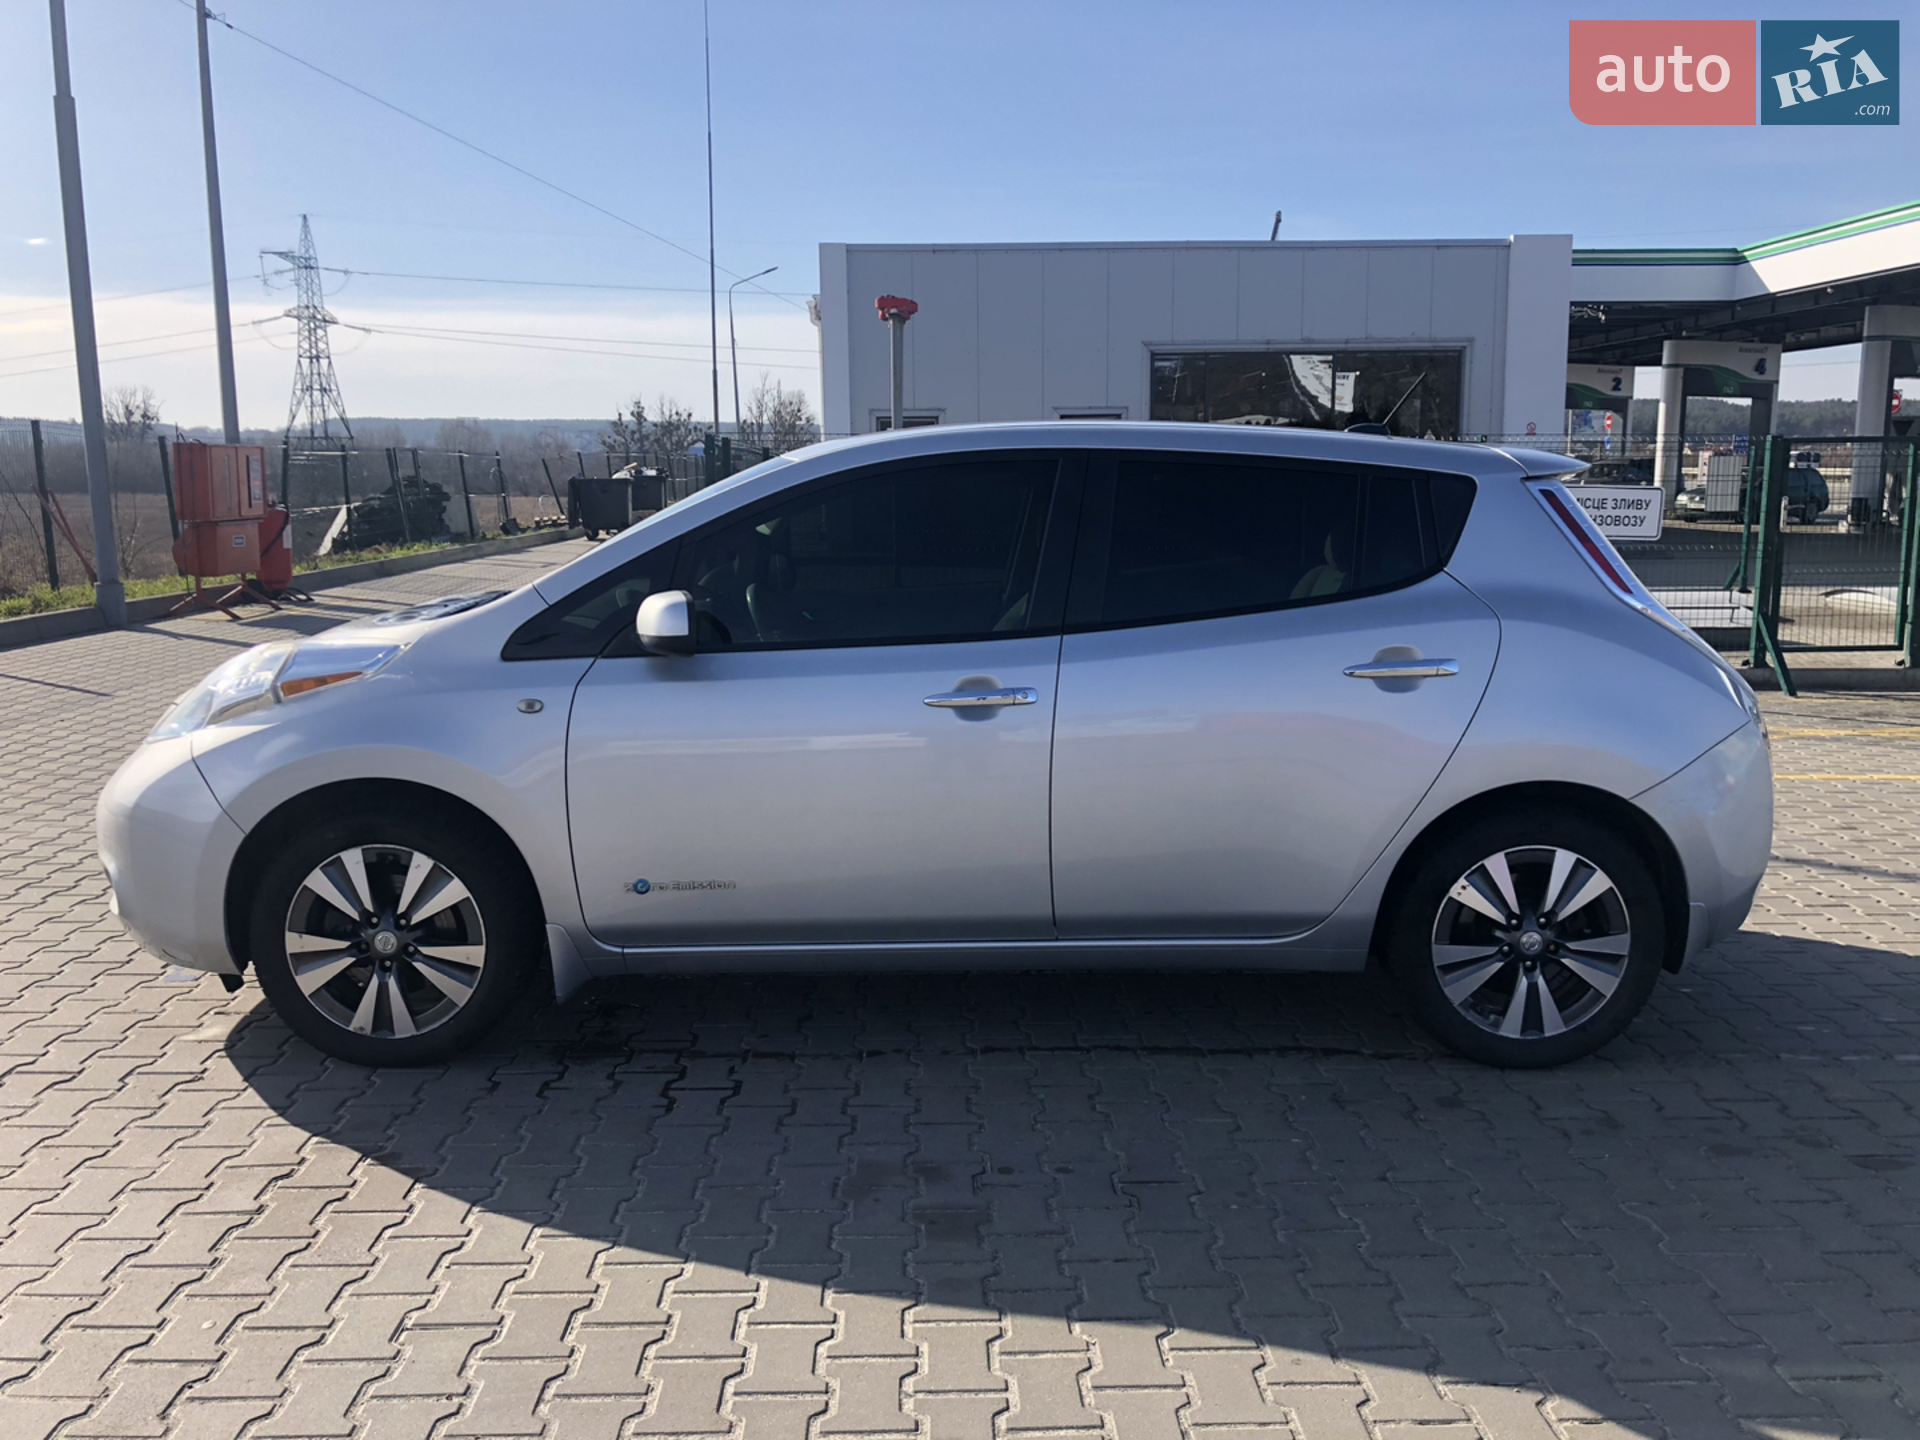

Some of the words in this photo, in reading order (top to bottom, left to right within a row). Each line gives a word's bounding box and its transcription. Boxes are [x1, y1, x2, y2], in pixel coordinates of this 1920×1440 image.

[1754, 357, 1767, 376] 4
[1611, 376, 1622, 392] 2
[1611, 498, 1652, 511] ЗЛИВУ
